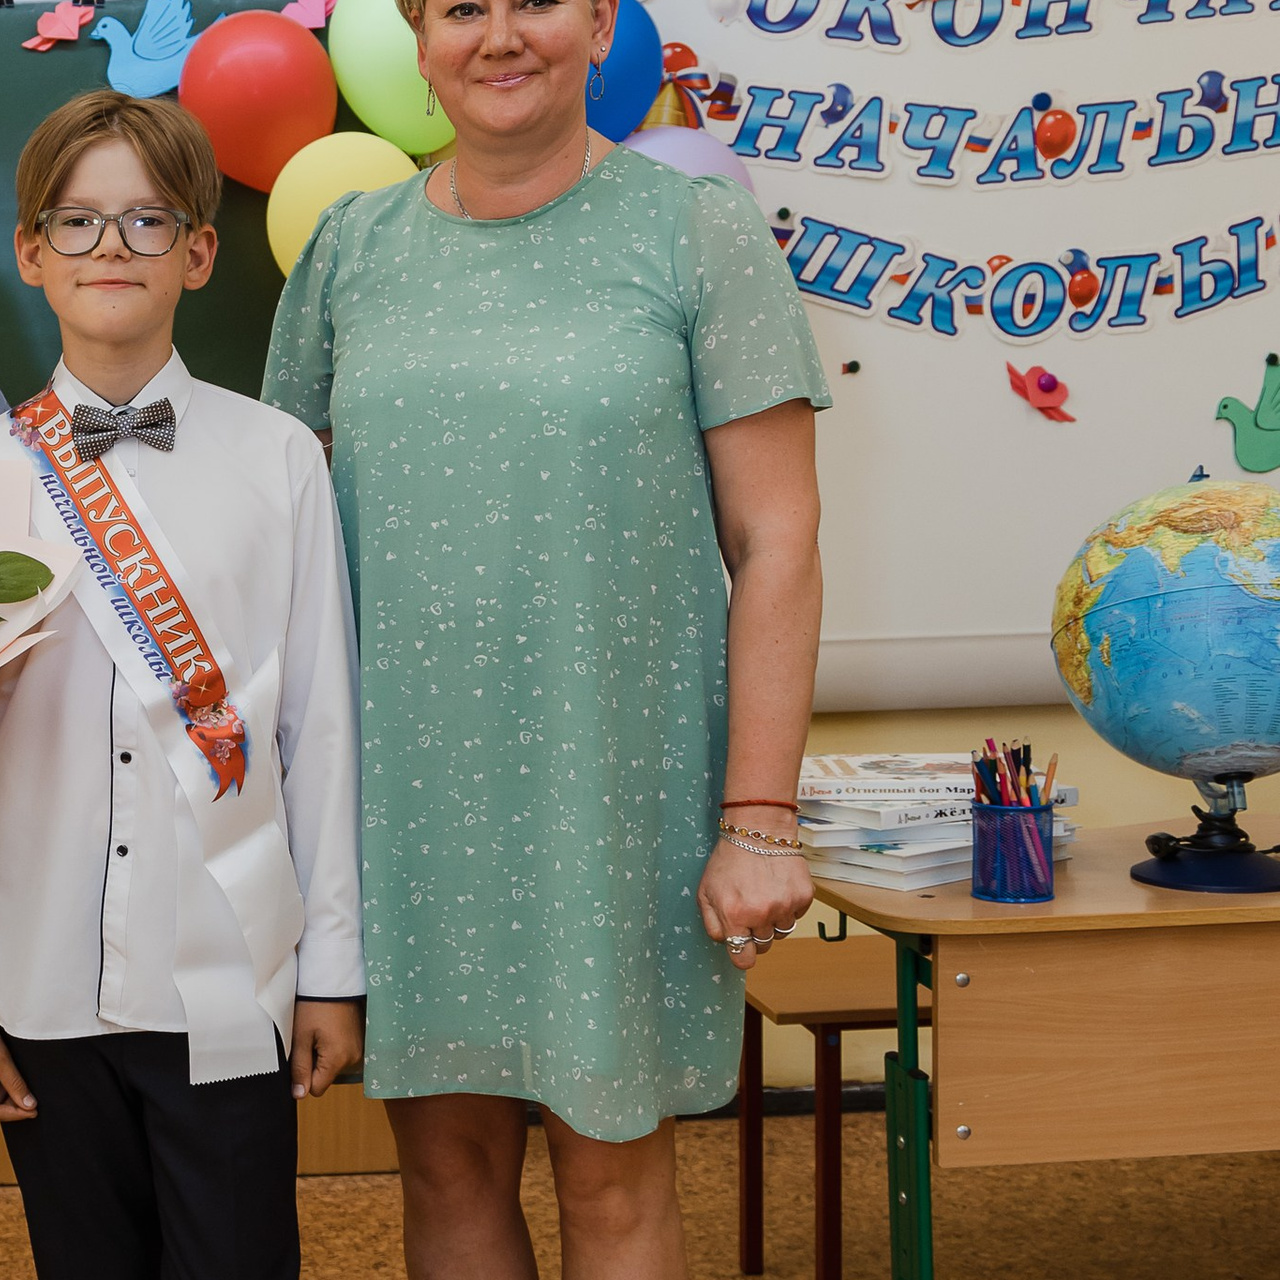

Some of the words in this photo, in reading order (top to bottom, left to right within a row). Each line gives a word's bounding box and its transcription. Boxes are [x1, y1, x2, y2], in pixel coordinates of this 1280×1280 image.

[783, 217, 1266, 337] ШКОЛЫ
[38, 409, 213, 684] ВЫПУСКНИК
[40, 472, 115, 591] начальной
[110, 596, 174, 683] школы
[845, 787, 917, 795] Огненный
[919, 787, 941, 795] бог
